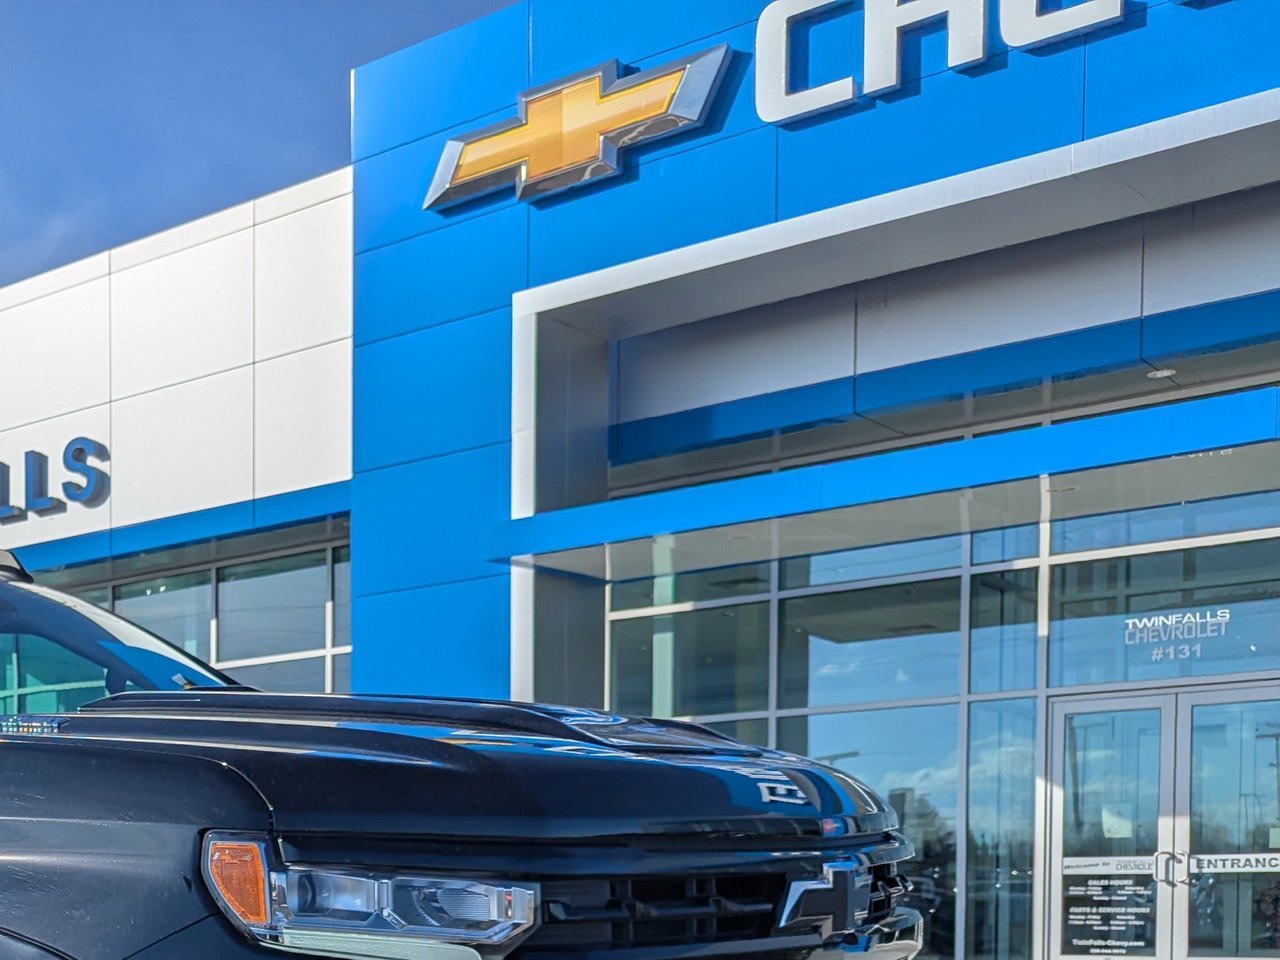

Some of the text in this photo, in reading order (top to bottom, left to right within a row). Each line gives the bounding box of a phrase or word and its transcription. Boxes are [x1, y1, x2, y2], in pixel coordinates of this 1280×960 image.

[1124, 609, 1230, 630] TWINFALLS
[1124, 620, 1227, 645] CHEVROLET
[1151, 643, 1202, 661] #131
